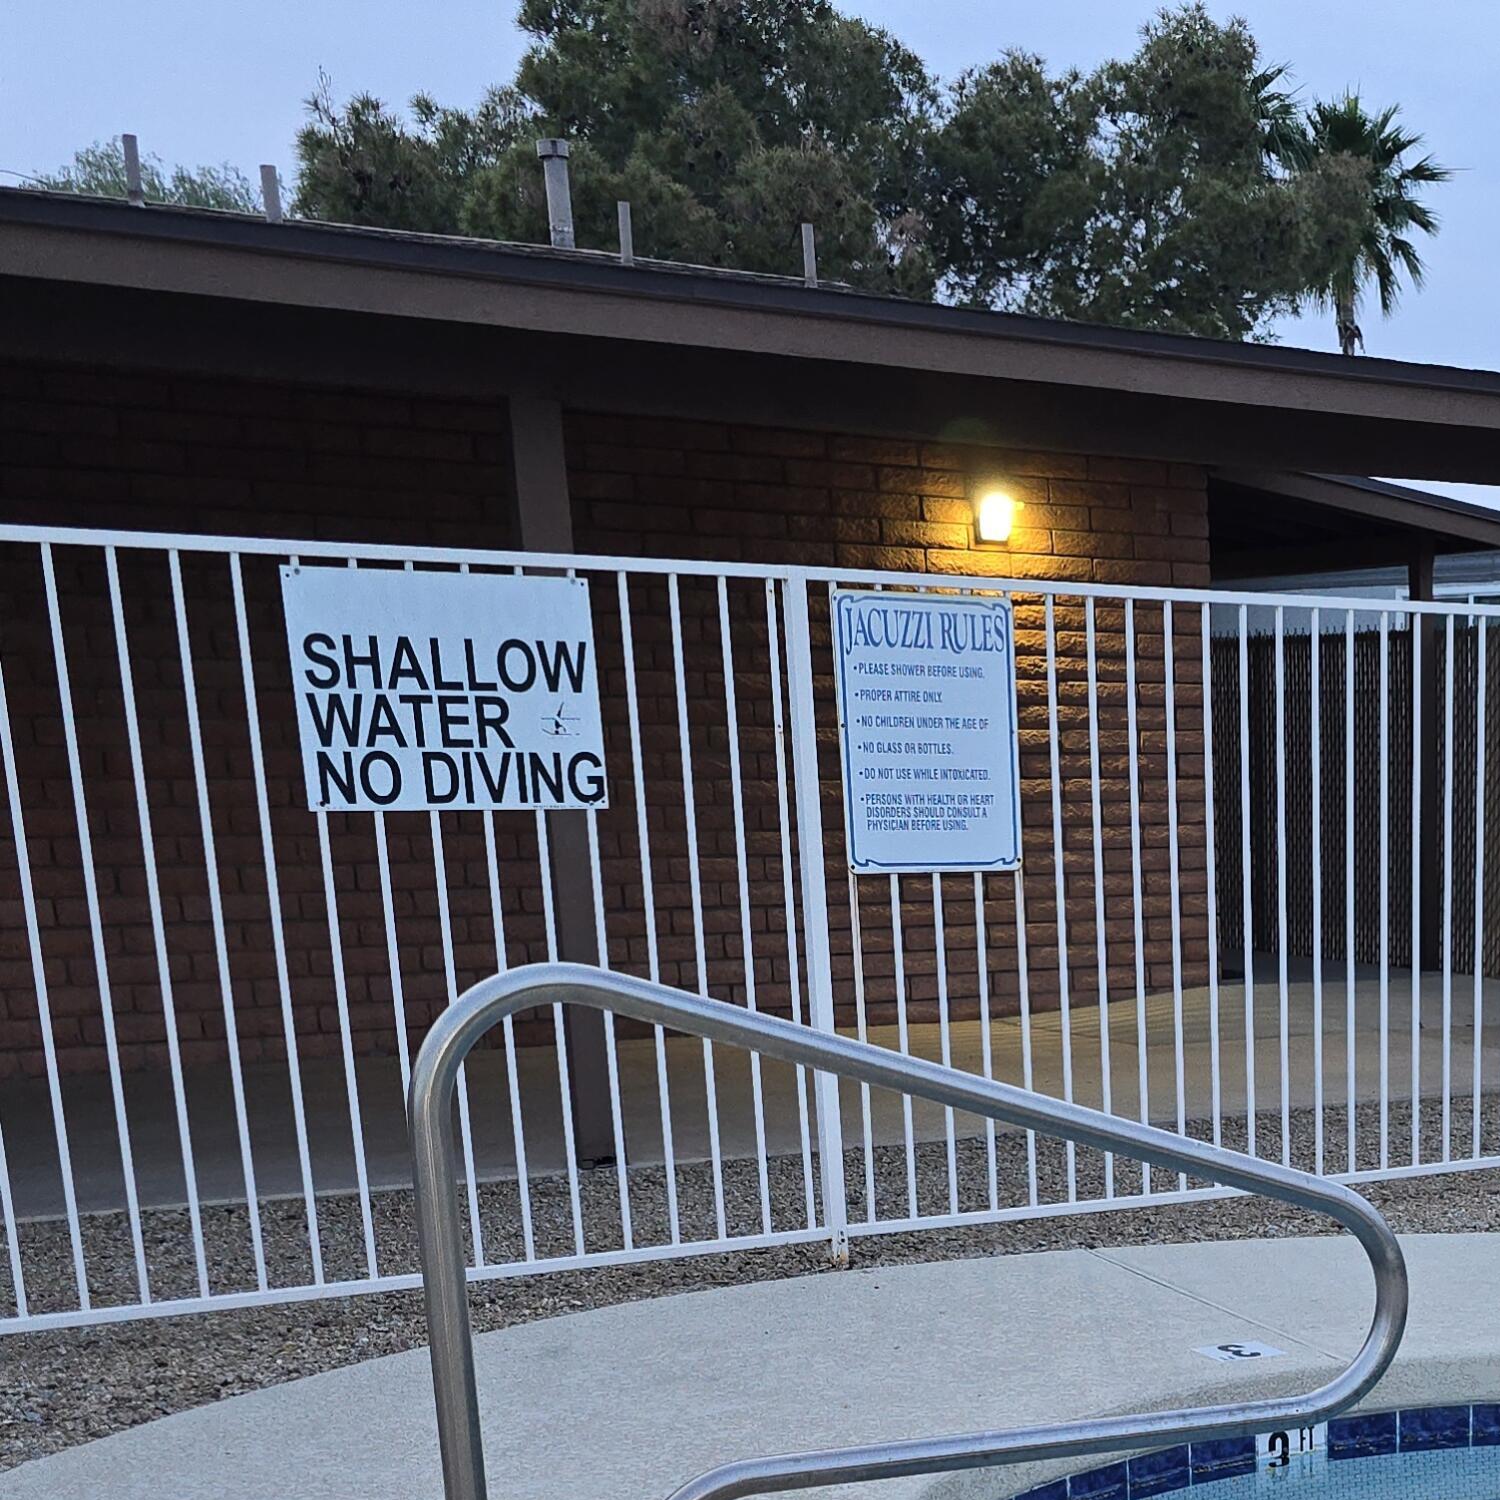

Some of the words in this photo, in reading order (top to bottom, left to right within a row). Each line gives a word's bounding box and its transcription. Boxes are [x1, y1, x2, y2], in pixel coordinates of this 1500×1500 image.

[845, 607, 934, 655] JACUZZI
[939, 612, 1005, 654] RULES
[303, 632, 587, 693] SHALLOW
[858, 662, 889, 675] PLEASE
[890, 663, 926, 677] SHOWER
[927, 665, 957, 677] BEFORE
[959, 666, 985, 678] USING.
[860, 689, 892, 701] PROPER
[894, 690, 921, 702] ATTIRE
[305, 692, 516, 748] WATER
[861, 715, 873, 727] NO
[875, 715, 915, 728] CHILDREN
[917, 716, 943, 729] UNDER
[945, 717, 961, 729] THE
[962, 717, 977, 730] AGE
[978, 718, 989, 730] OF
[863, 742, 874, 753] NO
[876, 742, 903, 754] GLASS
[904, 742, 916, 754] OR
[918, 742, 954, 755] BOTTLES.
[316, 751, 402, 805] NO
[421, 751, 607, 805] DIVING
[864, 767, 875, 780] DO
[878, 767, 894, 780] NOT
[896, 768, 912, 780] USE
[913, 768, 938, 780] WHILE
[940, 768, 991, 780] INTOXICATED.
[865, 793, 902, 805] PERSONS
[904, 794, 925, 805] WITH
[927, 794, 956, 805] HEALTH
[957, 794, 968, 805] OR
[970, 794, 994, 806] HEART
[866, 806, 911, 818] DISORDERS
[913, 806, 945, 818] SHOULD
[947, 806, 981, 818] CONSULT
[982, 806, 988, 818] A
[867, 819, 909, 831] PHYSICIAN
[911, 819, 941, 831] BEFORE
[1217, 1344, 1261, 1358] 3
